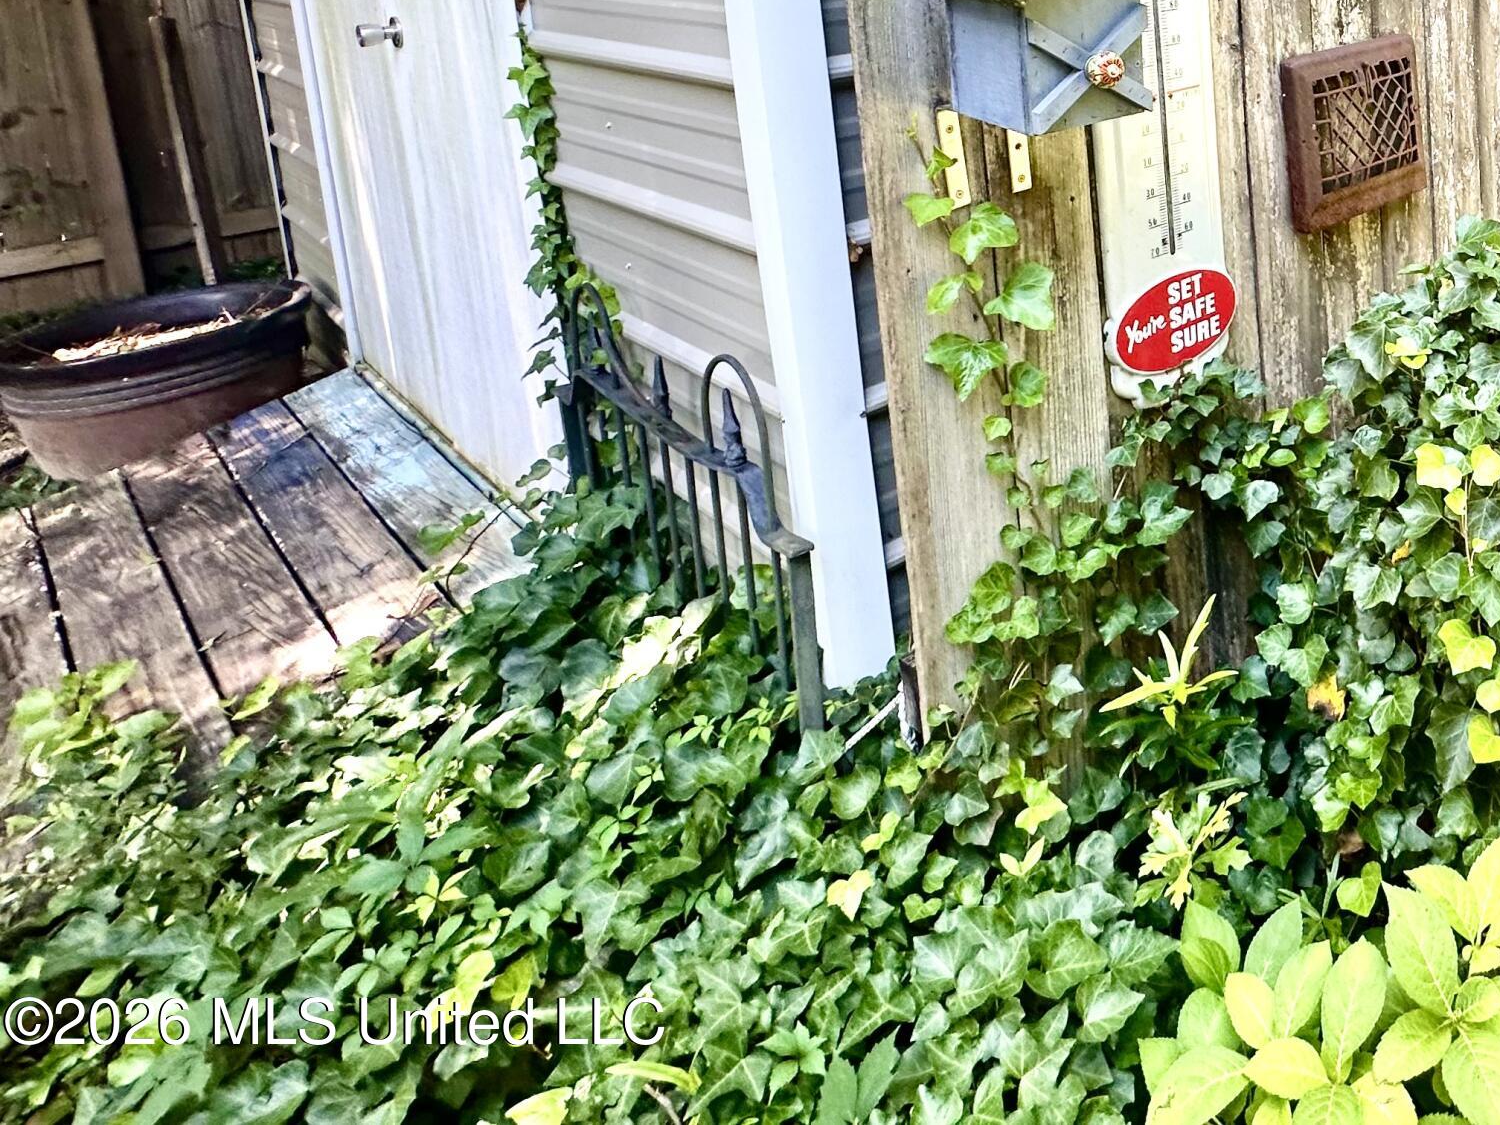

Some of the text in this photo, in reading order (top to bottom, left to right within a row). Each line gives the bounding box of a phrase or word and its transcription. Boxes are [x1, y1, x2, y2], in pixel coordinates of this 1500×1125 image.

[1167, 273, 1203, 305] SET
[1168, 292, 1216, 329] SAFE
[1170, 314, 1221, 354] SURE
